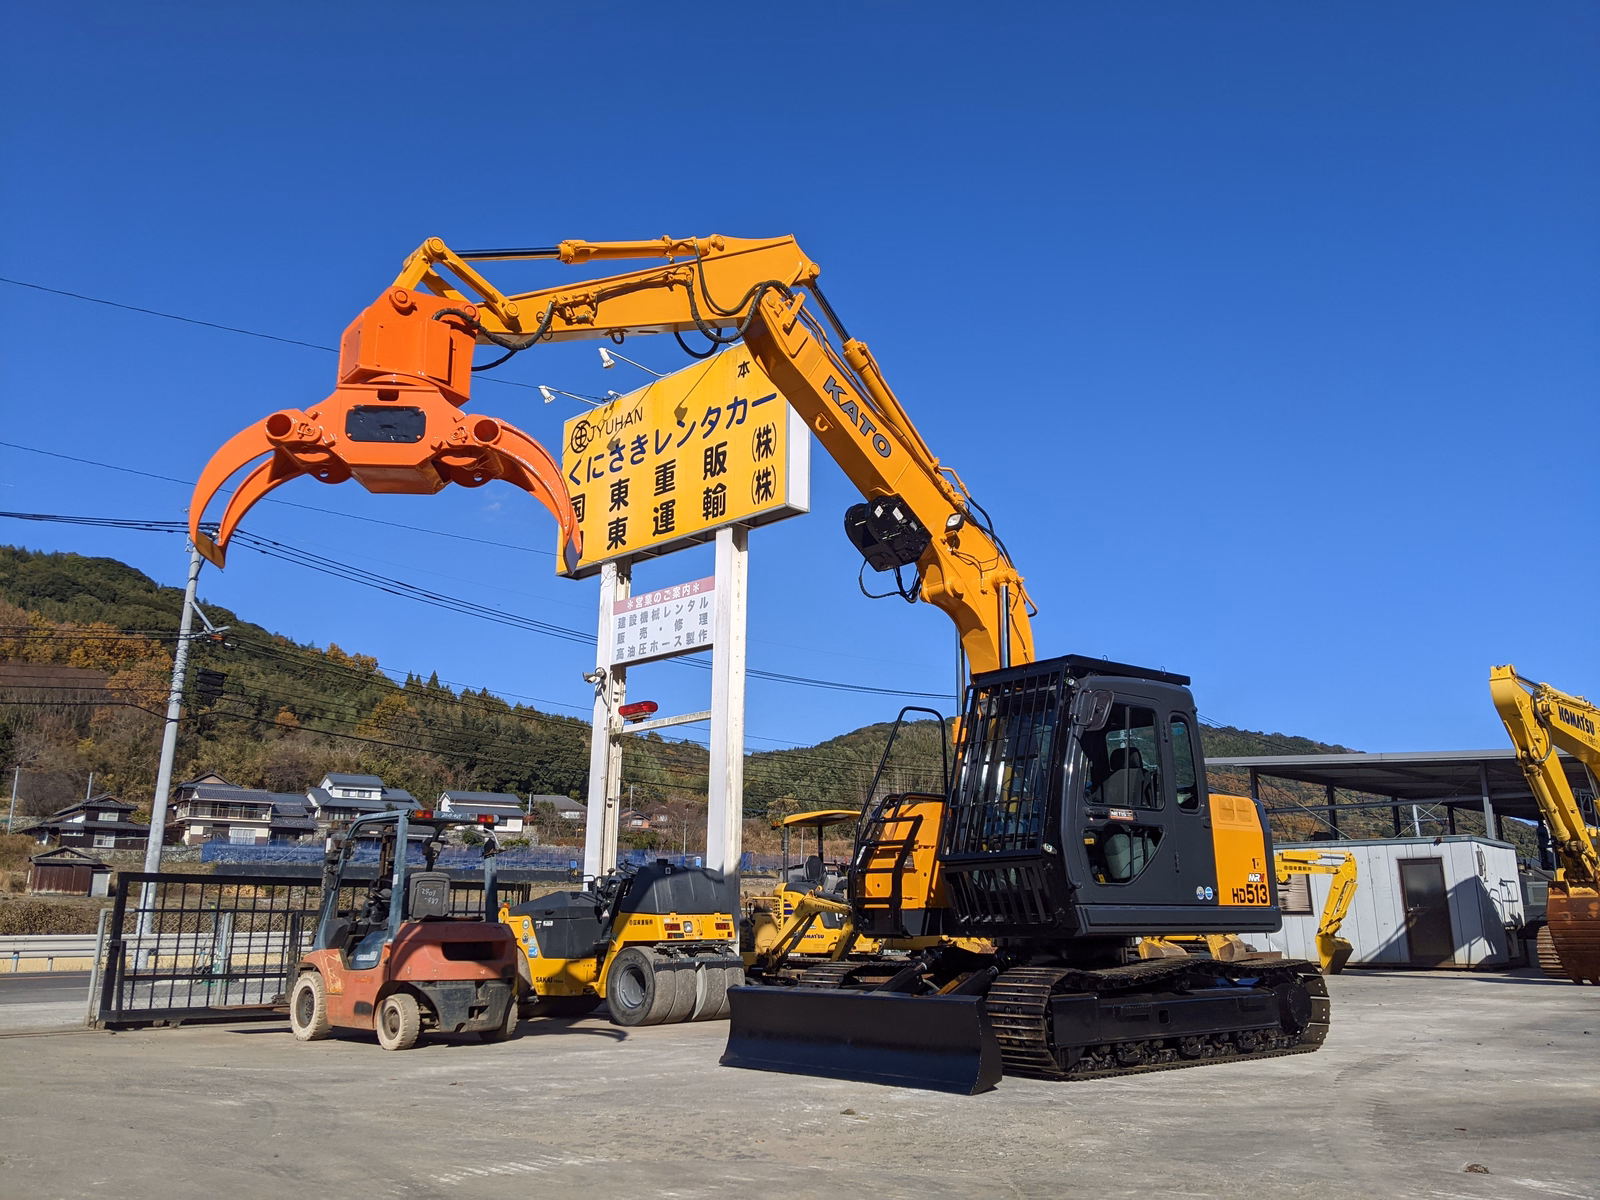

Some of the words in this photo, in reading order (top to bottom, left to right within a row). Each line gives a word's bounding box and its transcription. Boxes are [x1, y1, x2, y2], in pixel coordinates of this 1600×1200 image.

[587, 406, 643, 443] JYUHAN
[822, 374, 892, 459] KATO
[568, 392, 778, 486] くにさきレンタカー
[579, 464, 777, 560] 東運輸(株)
[617, 596, 709, 630] 建設機械レンタル
[615, 628, 709, 661] 高油圧ホース製作
[1558, 705, 1595, 737] KOMATSU
[1231, 883, 1269, 904] HD513
[535, 976, 553, 984] SAKAI
